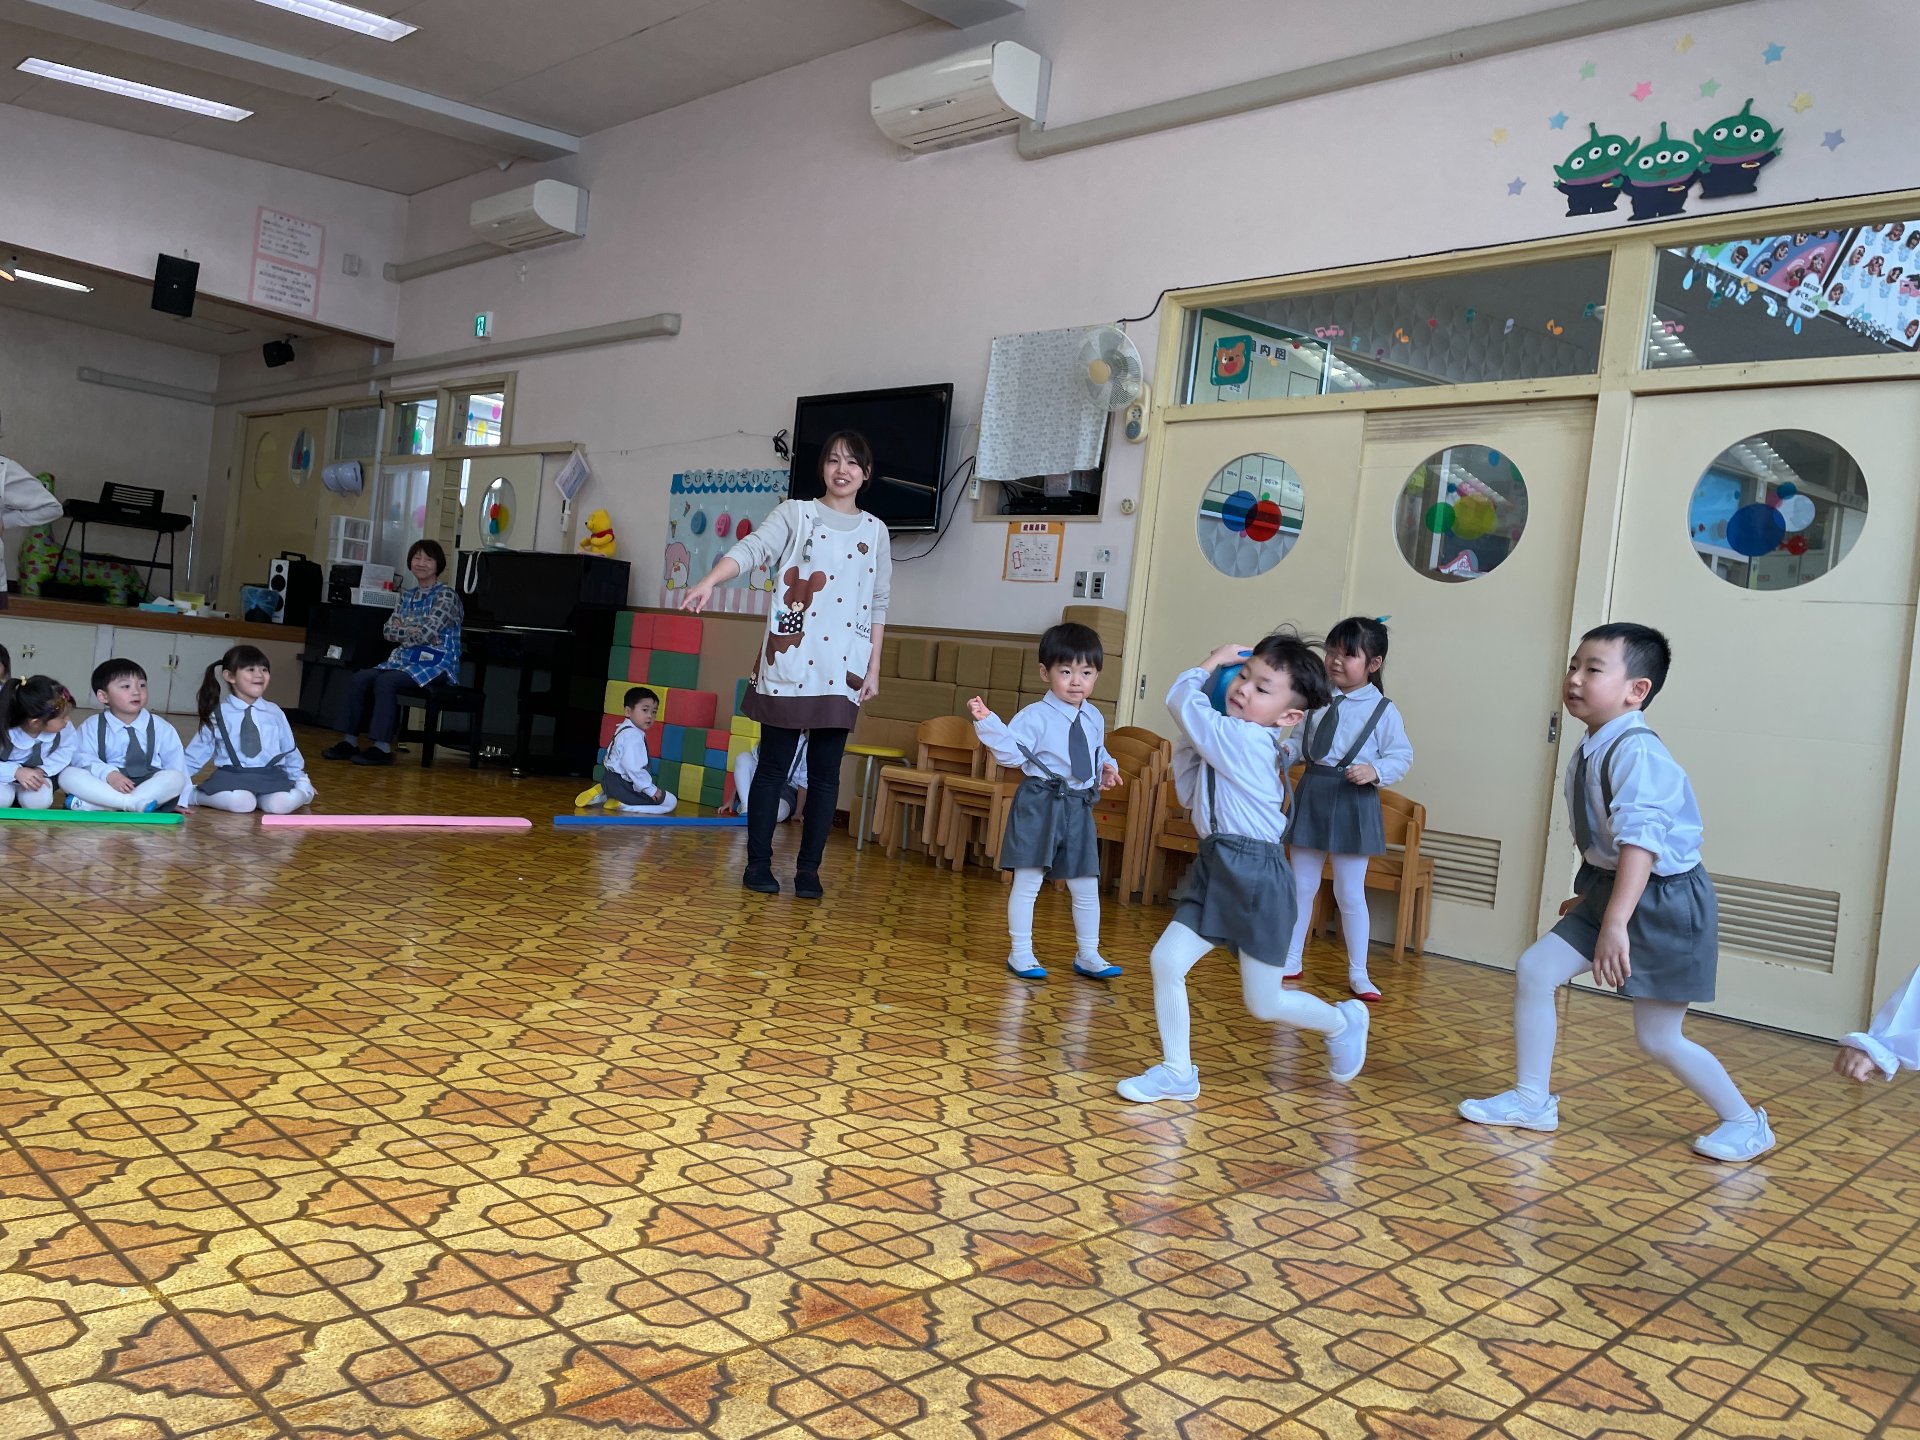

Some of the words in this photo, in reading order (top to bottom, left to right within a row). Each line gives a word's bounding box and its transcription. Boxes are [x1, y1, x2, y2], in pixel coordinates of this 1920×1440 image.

[683, 471, 790, 489] たいそうのだいひょ
